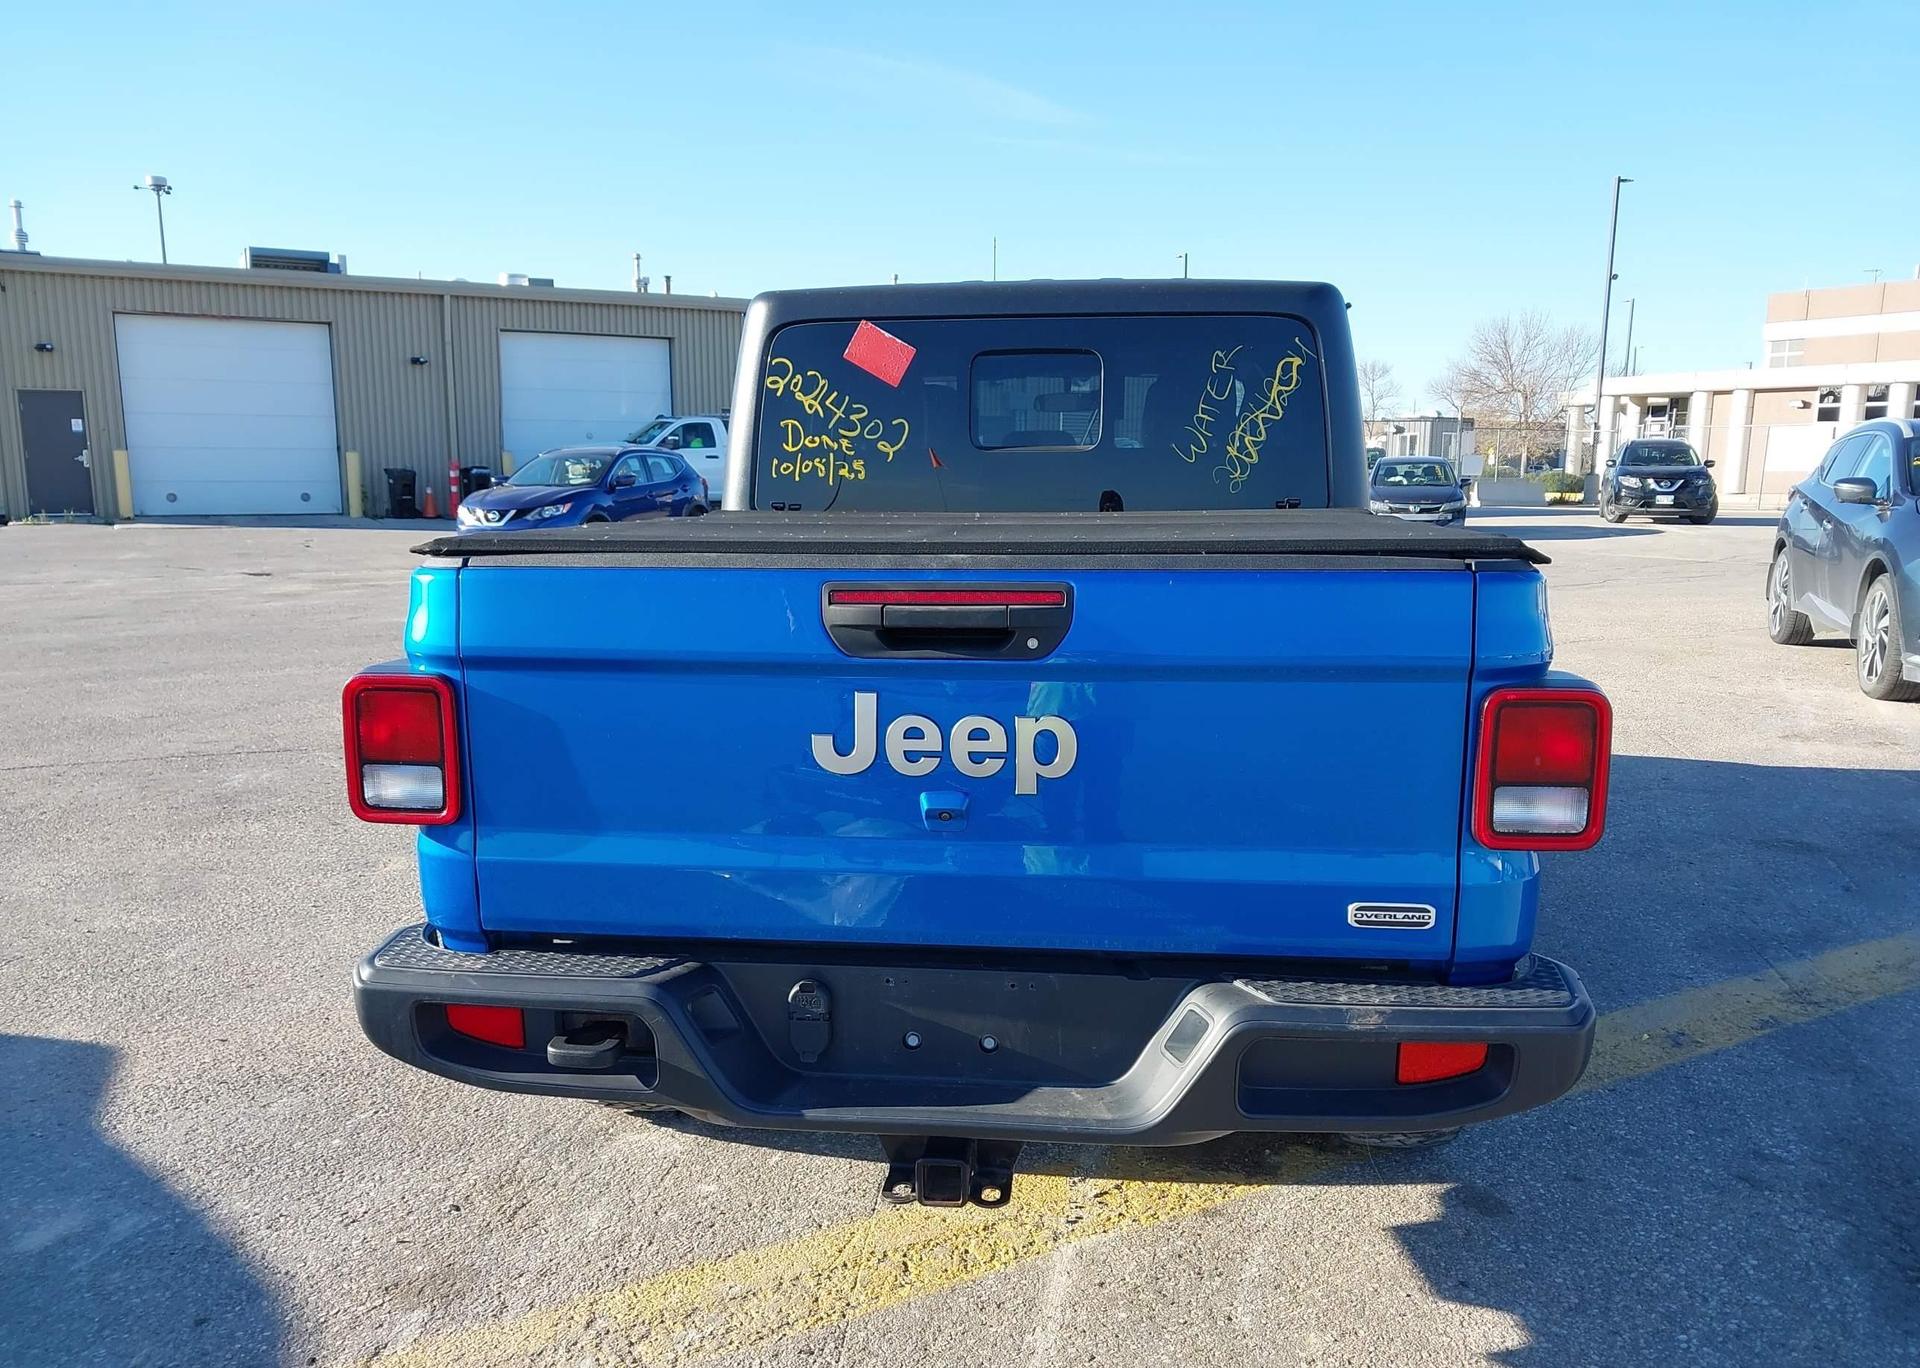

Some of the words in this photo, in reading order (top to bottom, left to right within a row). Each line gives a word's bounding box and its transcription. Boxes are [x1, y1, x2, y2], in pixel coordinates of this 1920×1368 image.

[1172, 344, 1244, 463] WATER
[811, 691, 1078, 795] Jeep
[1353, 912, 1432, 921] OVERLAND
